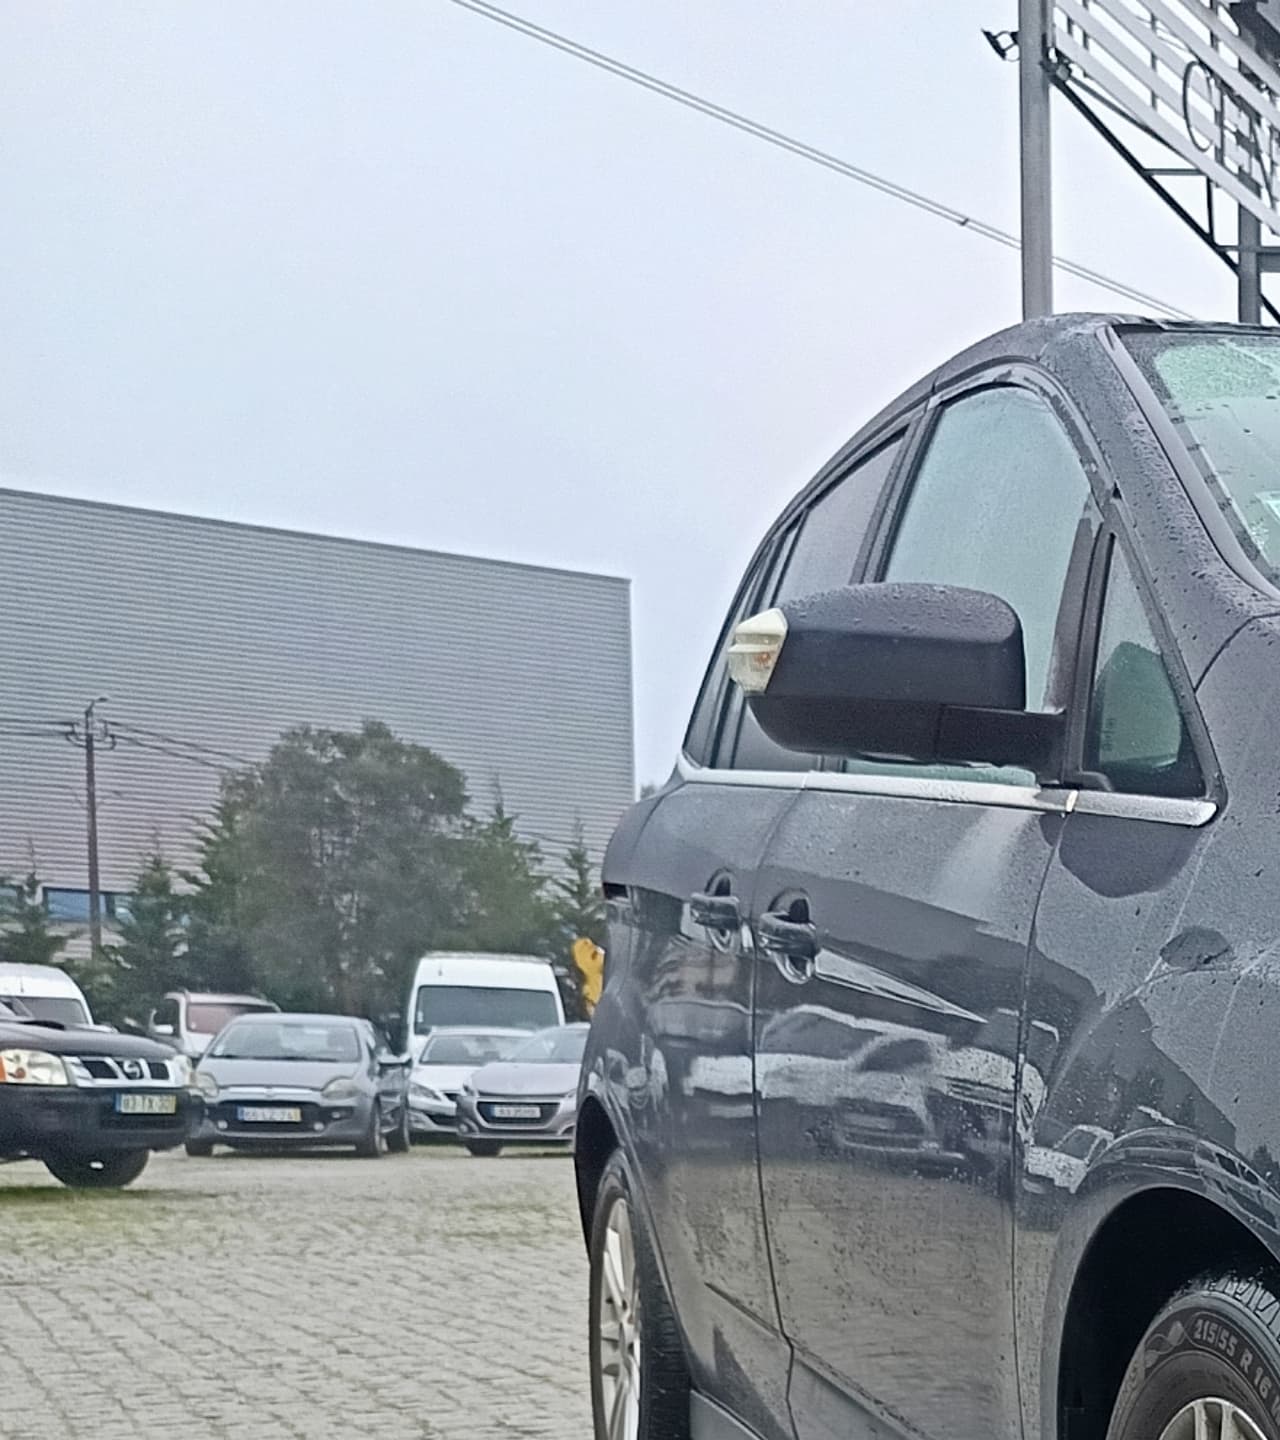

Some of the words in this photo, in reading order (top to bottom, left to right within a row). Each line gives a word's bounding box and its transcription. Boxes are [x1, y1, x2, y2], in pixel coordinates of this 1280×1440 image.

[1194, 1319, 1238, 1357] 215/55
[1240, 1348, 1253, 1374] R
[1254, 1367, 1272, 1398] 16
